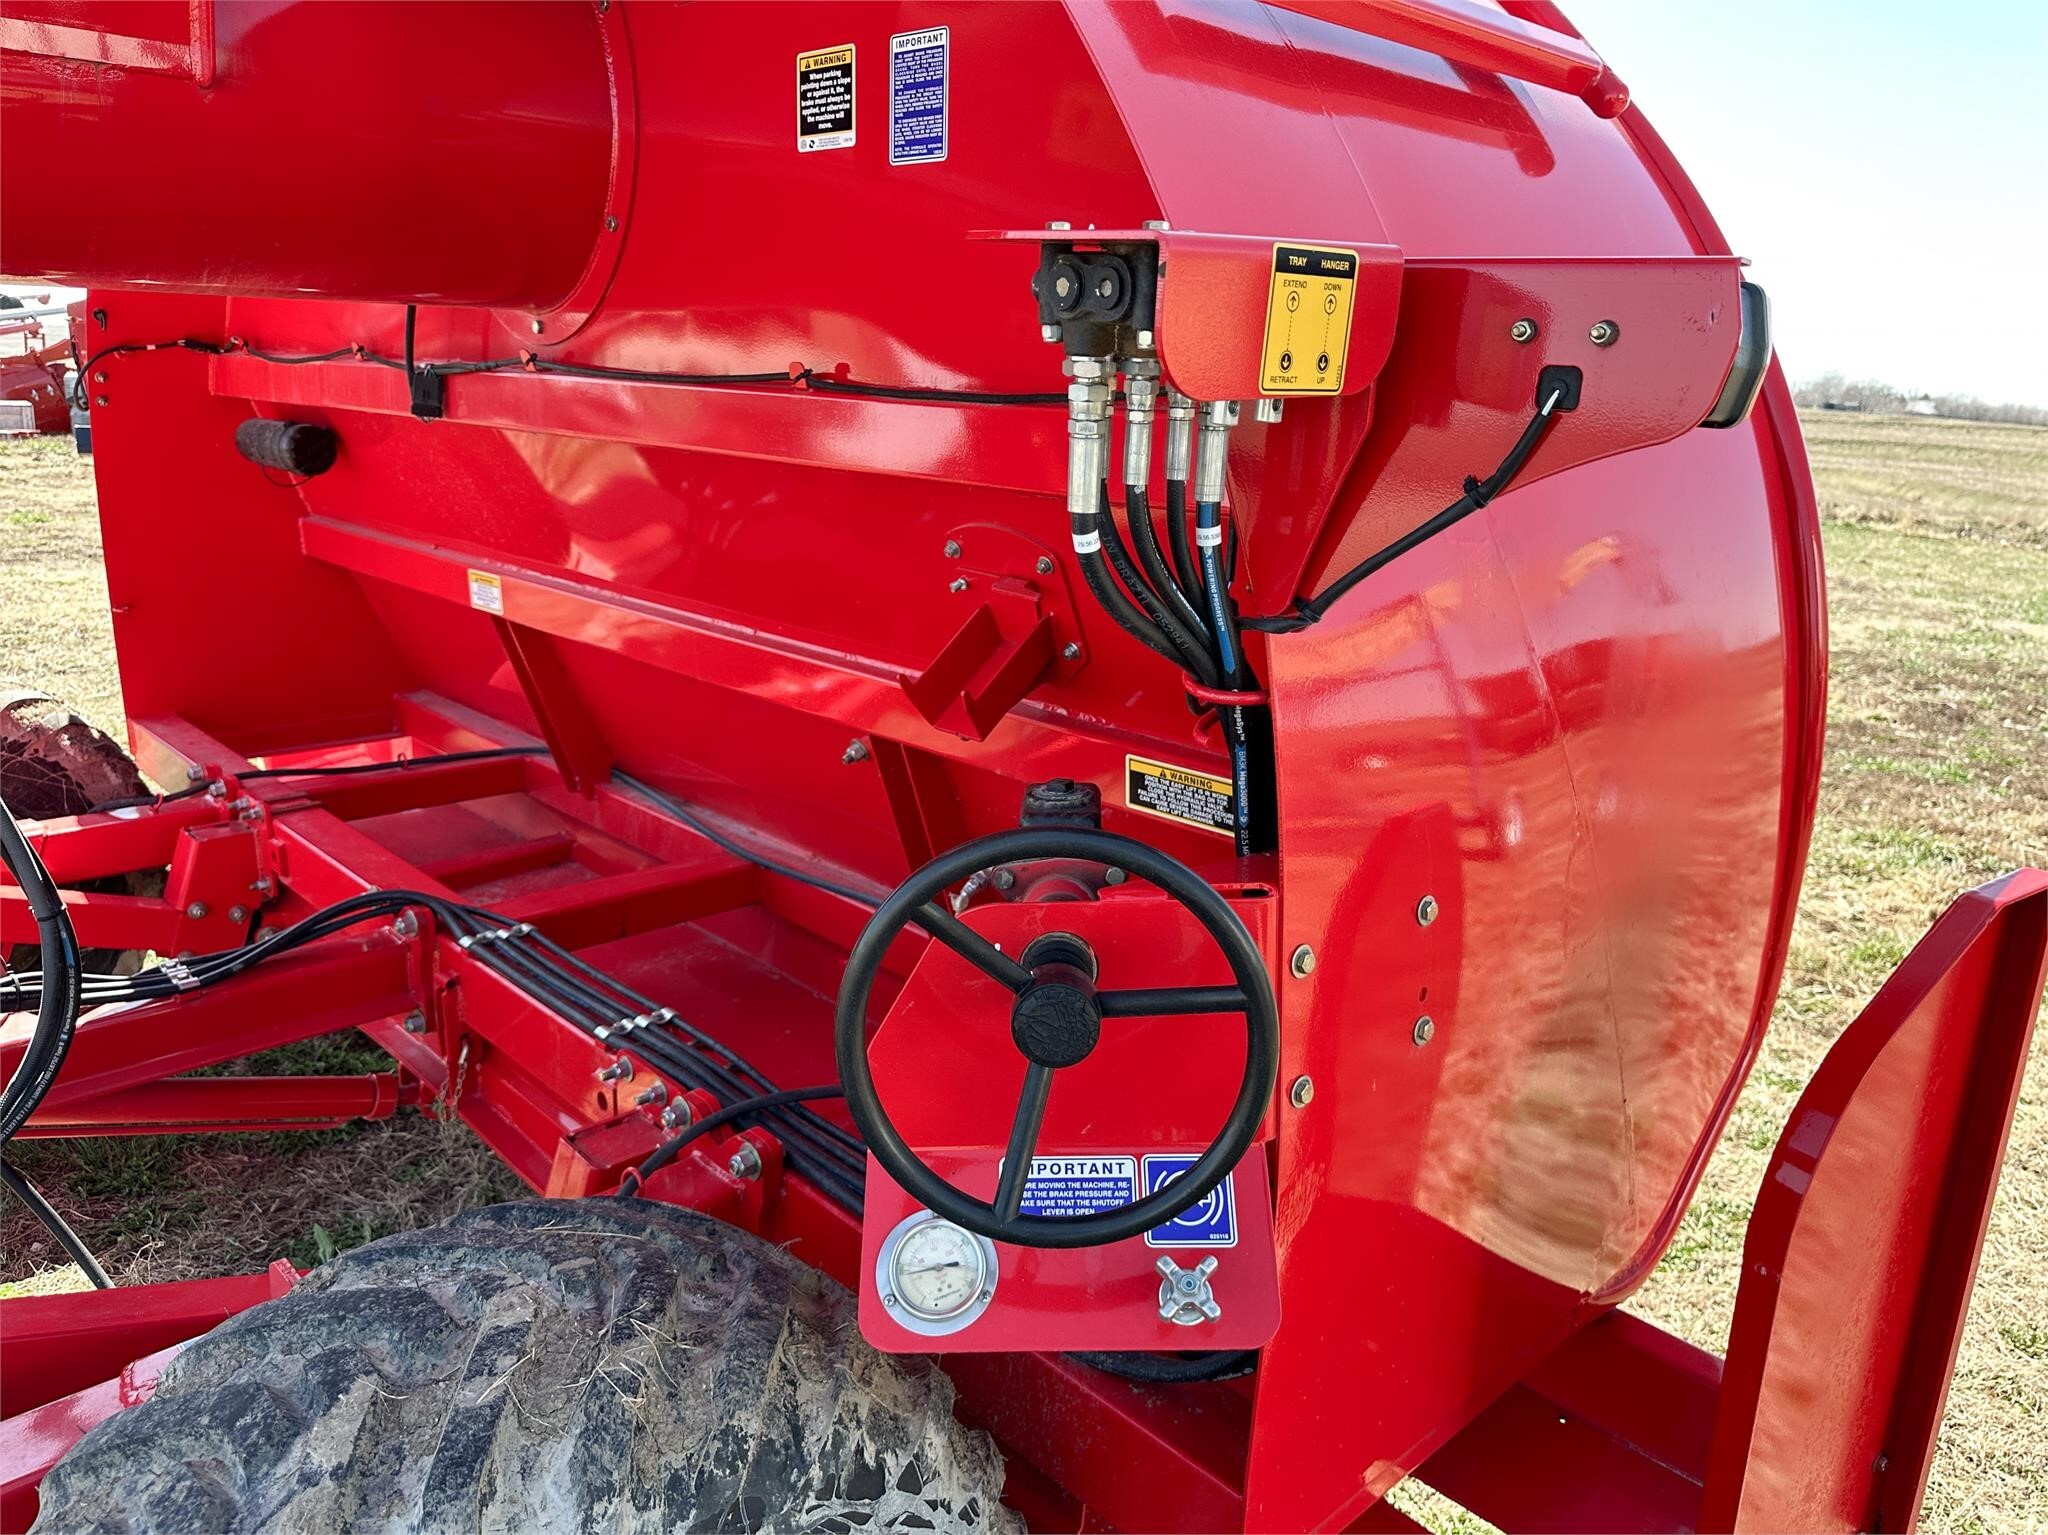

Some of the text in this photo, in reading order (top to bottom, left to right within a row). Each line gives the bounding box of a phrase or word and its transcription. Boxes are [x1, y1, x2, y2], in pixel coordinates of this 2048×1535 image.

[896, 33, 944, 49] IMPORTANT
[814, 54, 847, 66] WARNING
[809, 69, 842, 80] When parking
[820, 79, 833, 87] down
[838, 76, 851, 86] slope
[813, 88, 830, 98] against
[802, 99, 814, 107] brake
[844, 93, 851, 101] be
[1289, 256, 1350, 271] TRAY HANGER
[1283, 279, 1342, 292] EXTEND DOWN
[1270, 376, 1325, 384] RETRACT UP
[1170, 772, 1213, 790] WARNING
[1030, 1162, 1125, 1175] PORTANT
[1082, 1182, 1117, 1190] MACHINE,
[1075, 1190, 1112, 1198] PRESSURE
[1057, 1199, 1075, 1207] THAT
[1076, 1199, 1090, 1207] THE
[1092, 1199, 1124, 1207] SHUTOFF
